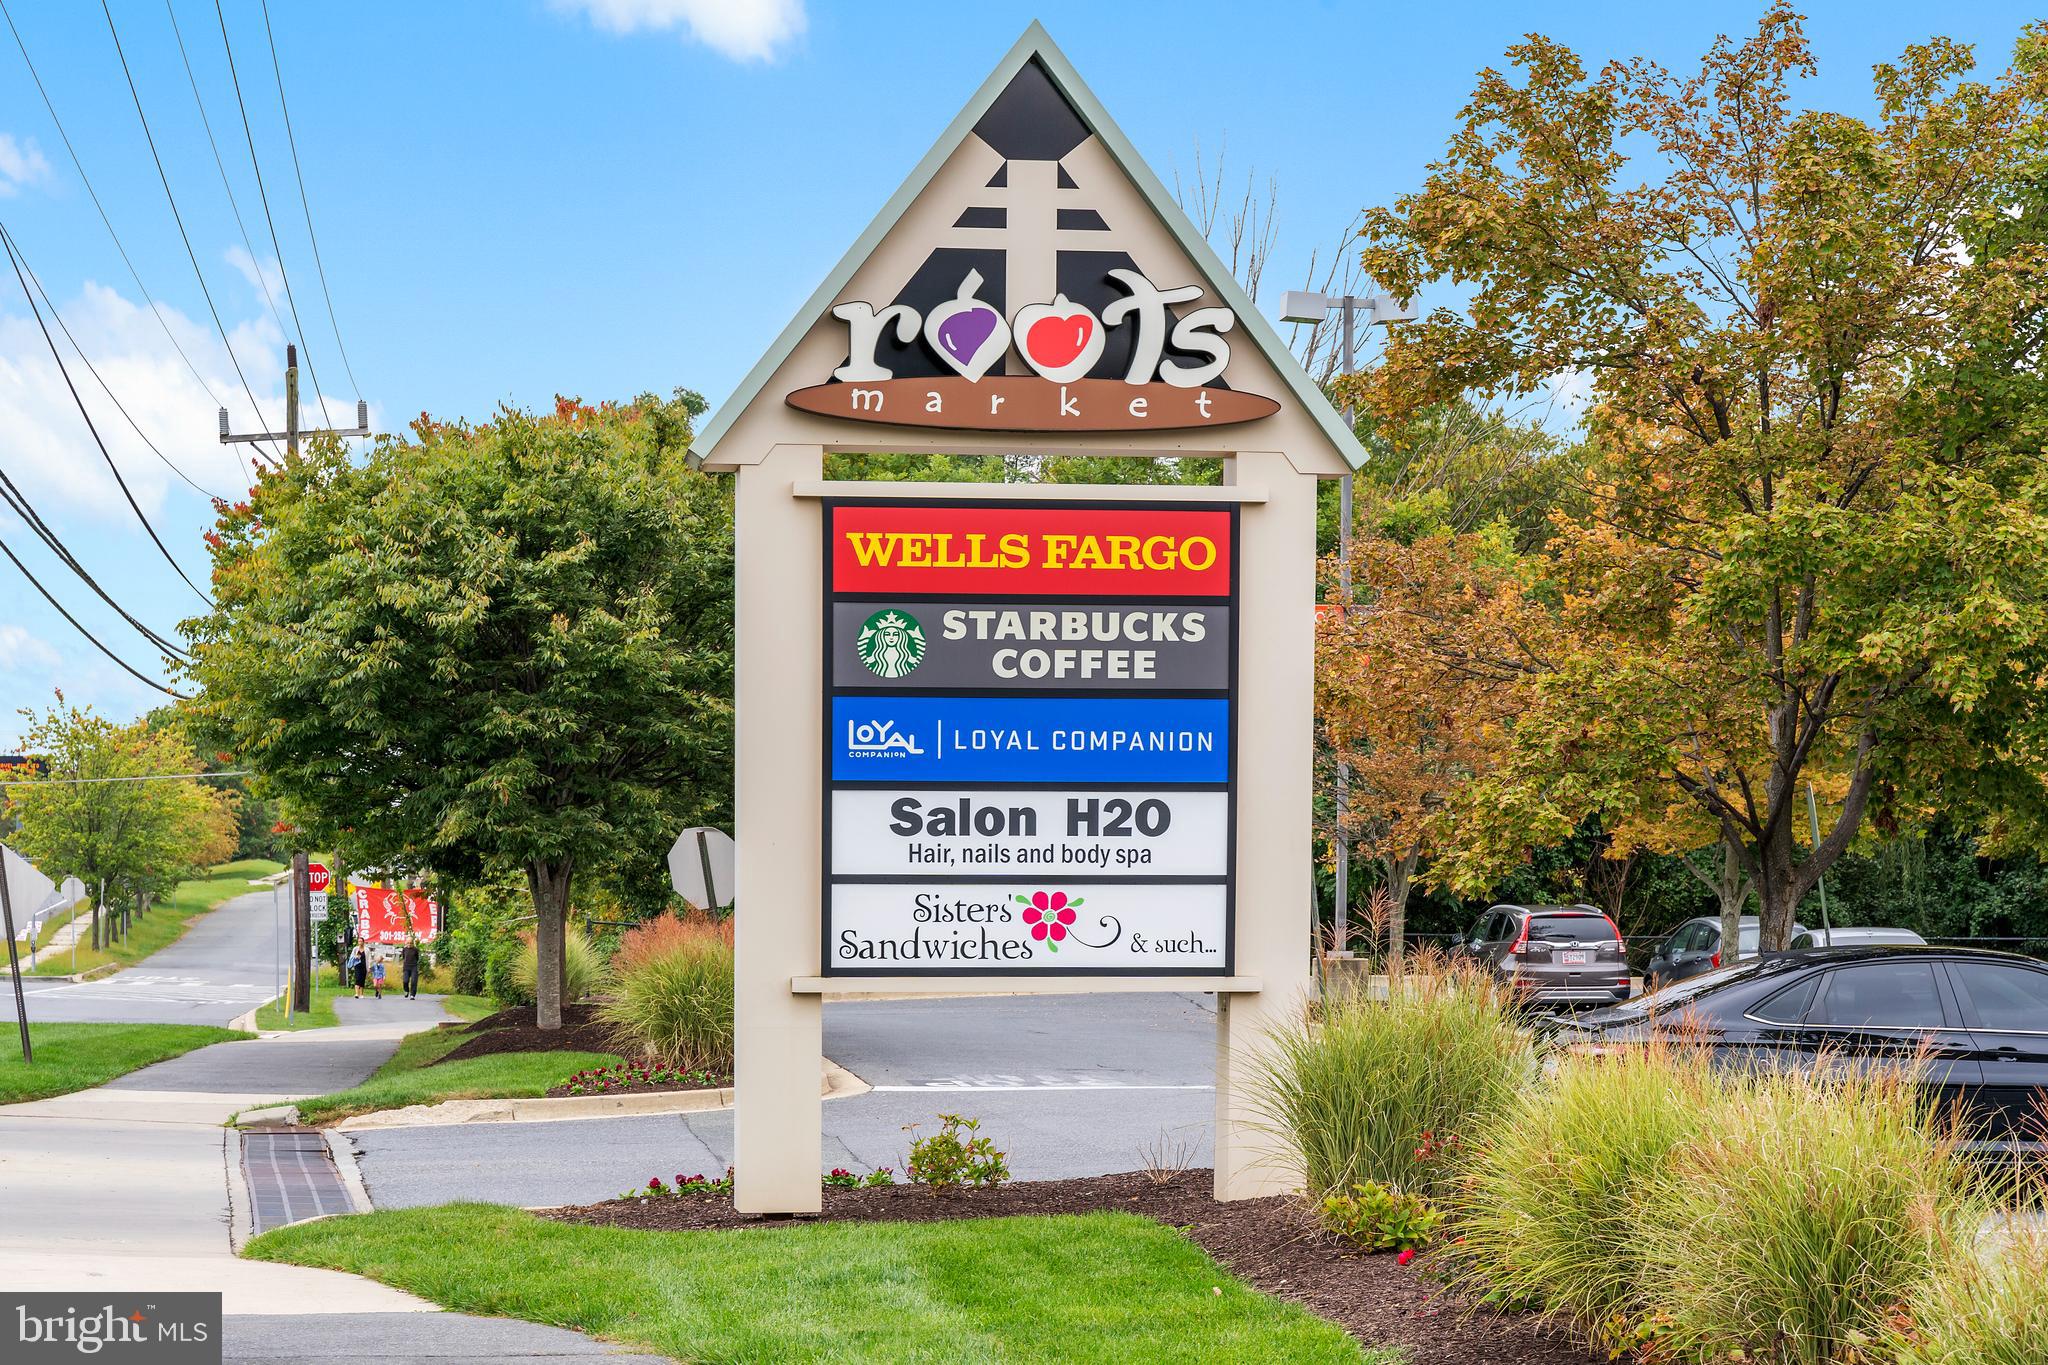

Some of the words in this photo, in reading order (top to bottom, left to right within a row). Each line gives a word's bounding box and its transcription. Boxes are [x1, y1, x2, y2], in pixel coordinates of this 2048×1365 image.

[832, 268, 1235, 388] roots
[851, 386, 1212, 419] market
[845, 532, 1031, 569] WELLS
[1042, 534, 1217, 571] FARGO
[942, 609, 1206, 643] STARBUCKS
[992, 648, 1156, 679] COFFEE
[848, 751, 906, 759] COMPANION
[954, 729, 1040, 750] LOYAL
[1052, 730, 1213, 752] COMPANION
[889, 797, 1037, 837] Salon
[909, 843, 955, 867] Hair,
[962, 843, 1011, 864] nails
[1017, 843, 1054, 864] and
[1061, 843, 1110, 869] body
[1115, 848, 1152, 869] spa
[309, 872, 328, 884] TOP
[315, 895, 326, 903] NOT
[357, 889, 371, 940] CRABS
[913, 893, 1012, 923] Sisters'
[839, 926, 1033, 960] Sandwiches
[1130, 932, 1149, 953] &
[1155, 930, 1217, 954] such...
